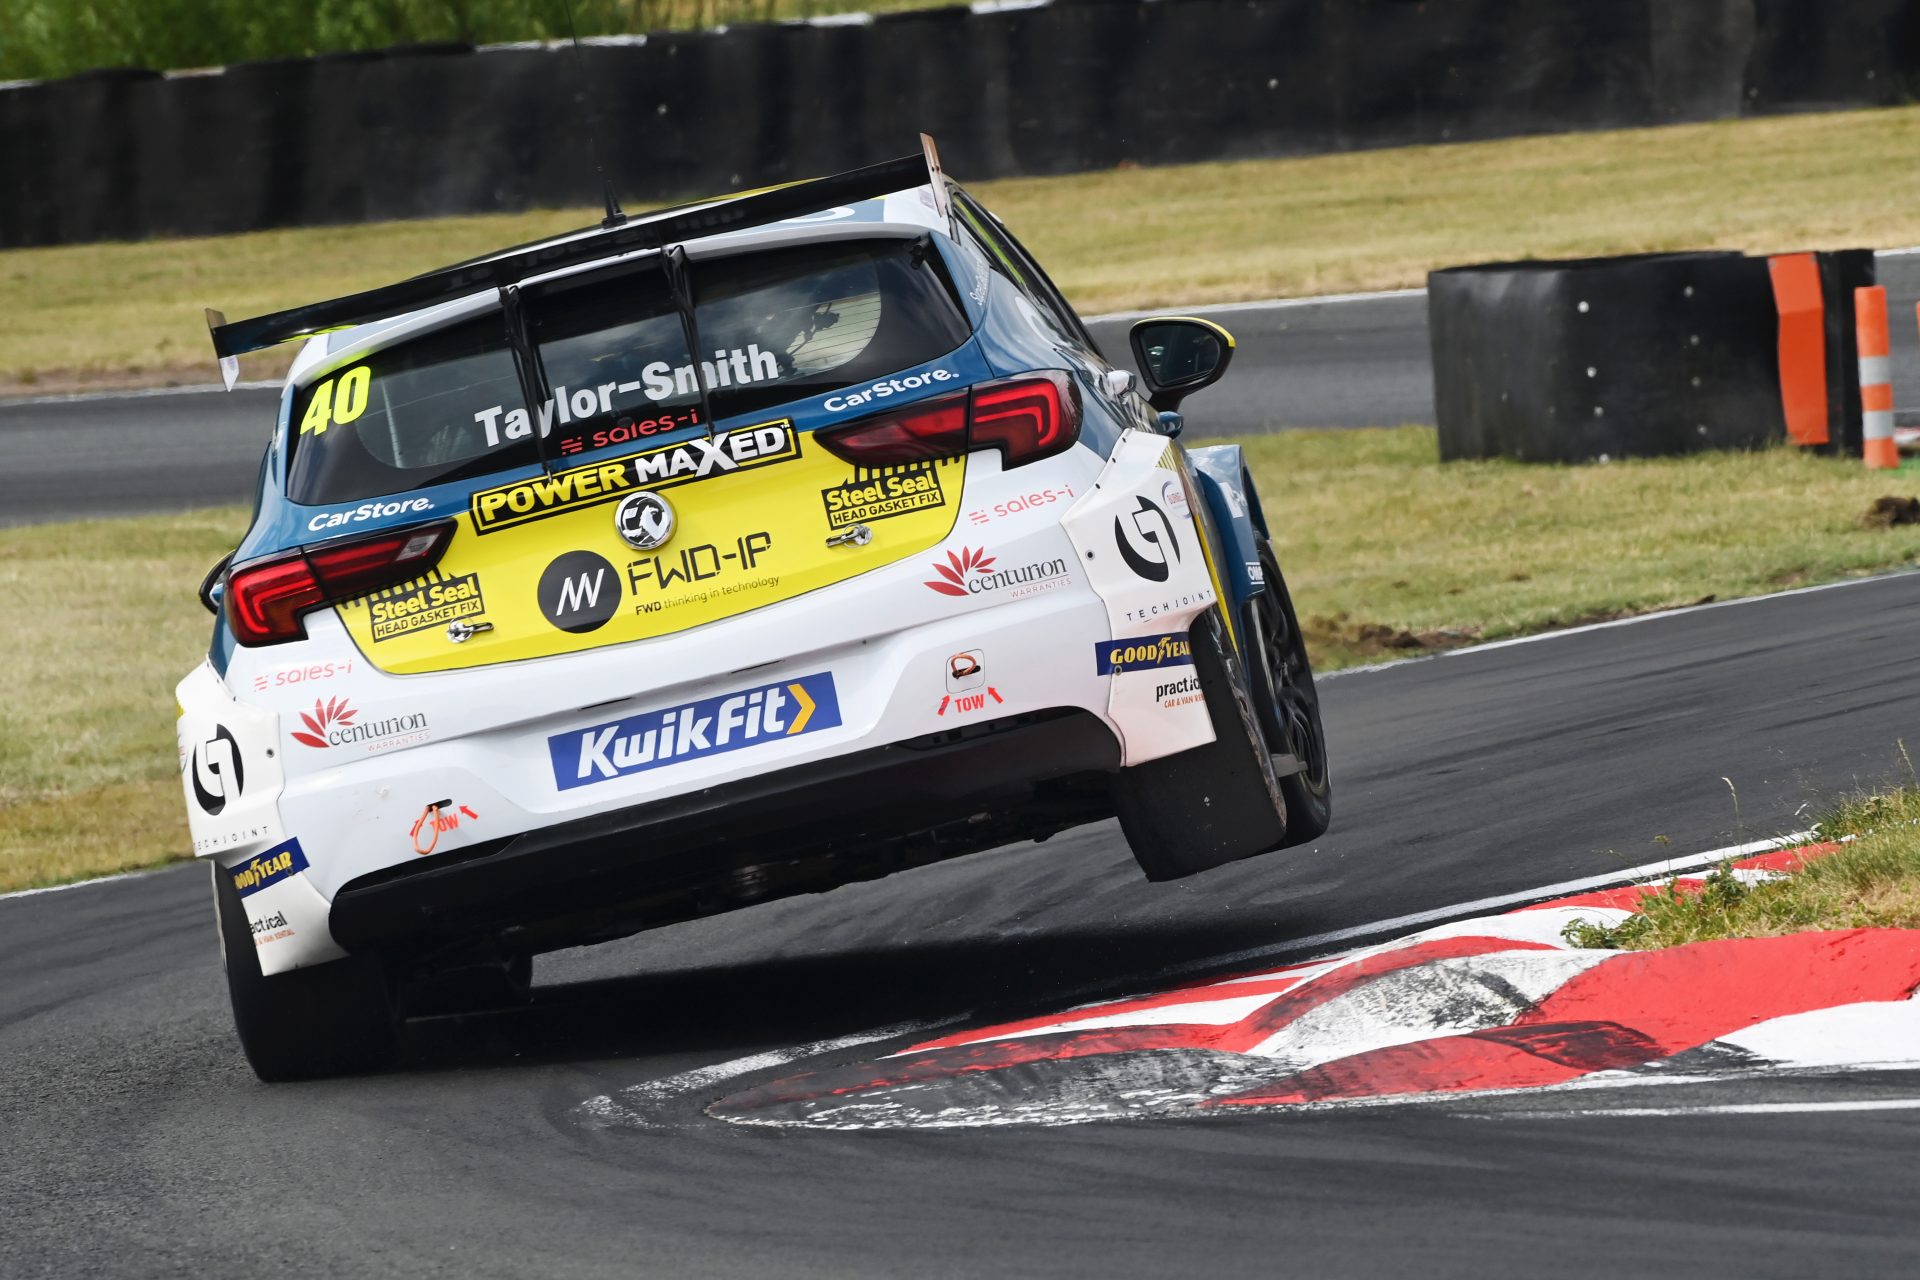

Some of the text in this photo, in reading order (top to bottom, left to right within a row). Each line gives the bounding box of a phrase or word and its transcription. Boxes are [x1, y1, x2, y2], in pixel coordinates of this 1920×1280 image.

[299, 365, 372, 437] 40
[474, 343, 779, 447] Taylor-Smith
[593, 408, 699, 448] sales-i
[480, 463, 631, 522] POWER
[826, 470, 937, 511] Steel Seal
[832, 491, 940, 525] HEAD GASKET FIX
[993, 484, 1075, 518] sales-i
[968, 557, 1067, 594] centurion
[1010, 577, 1073, 599] WARRANTIES
[372, 575, 479, 623] Steel Seal
[635, 576, 780, 616] FWD thinking in technology
[376, 600, 480, 637] HEAD GASKET FIX
[275, 659, 353, 687] sales-i
[955, 693, 985, 713] TOW
[328, 712, 428, 747] centurion
[368, 733, 432, 752] WARRANTIES
